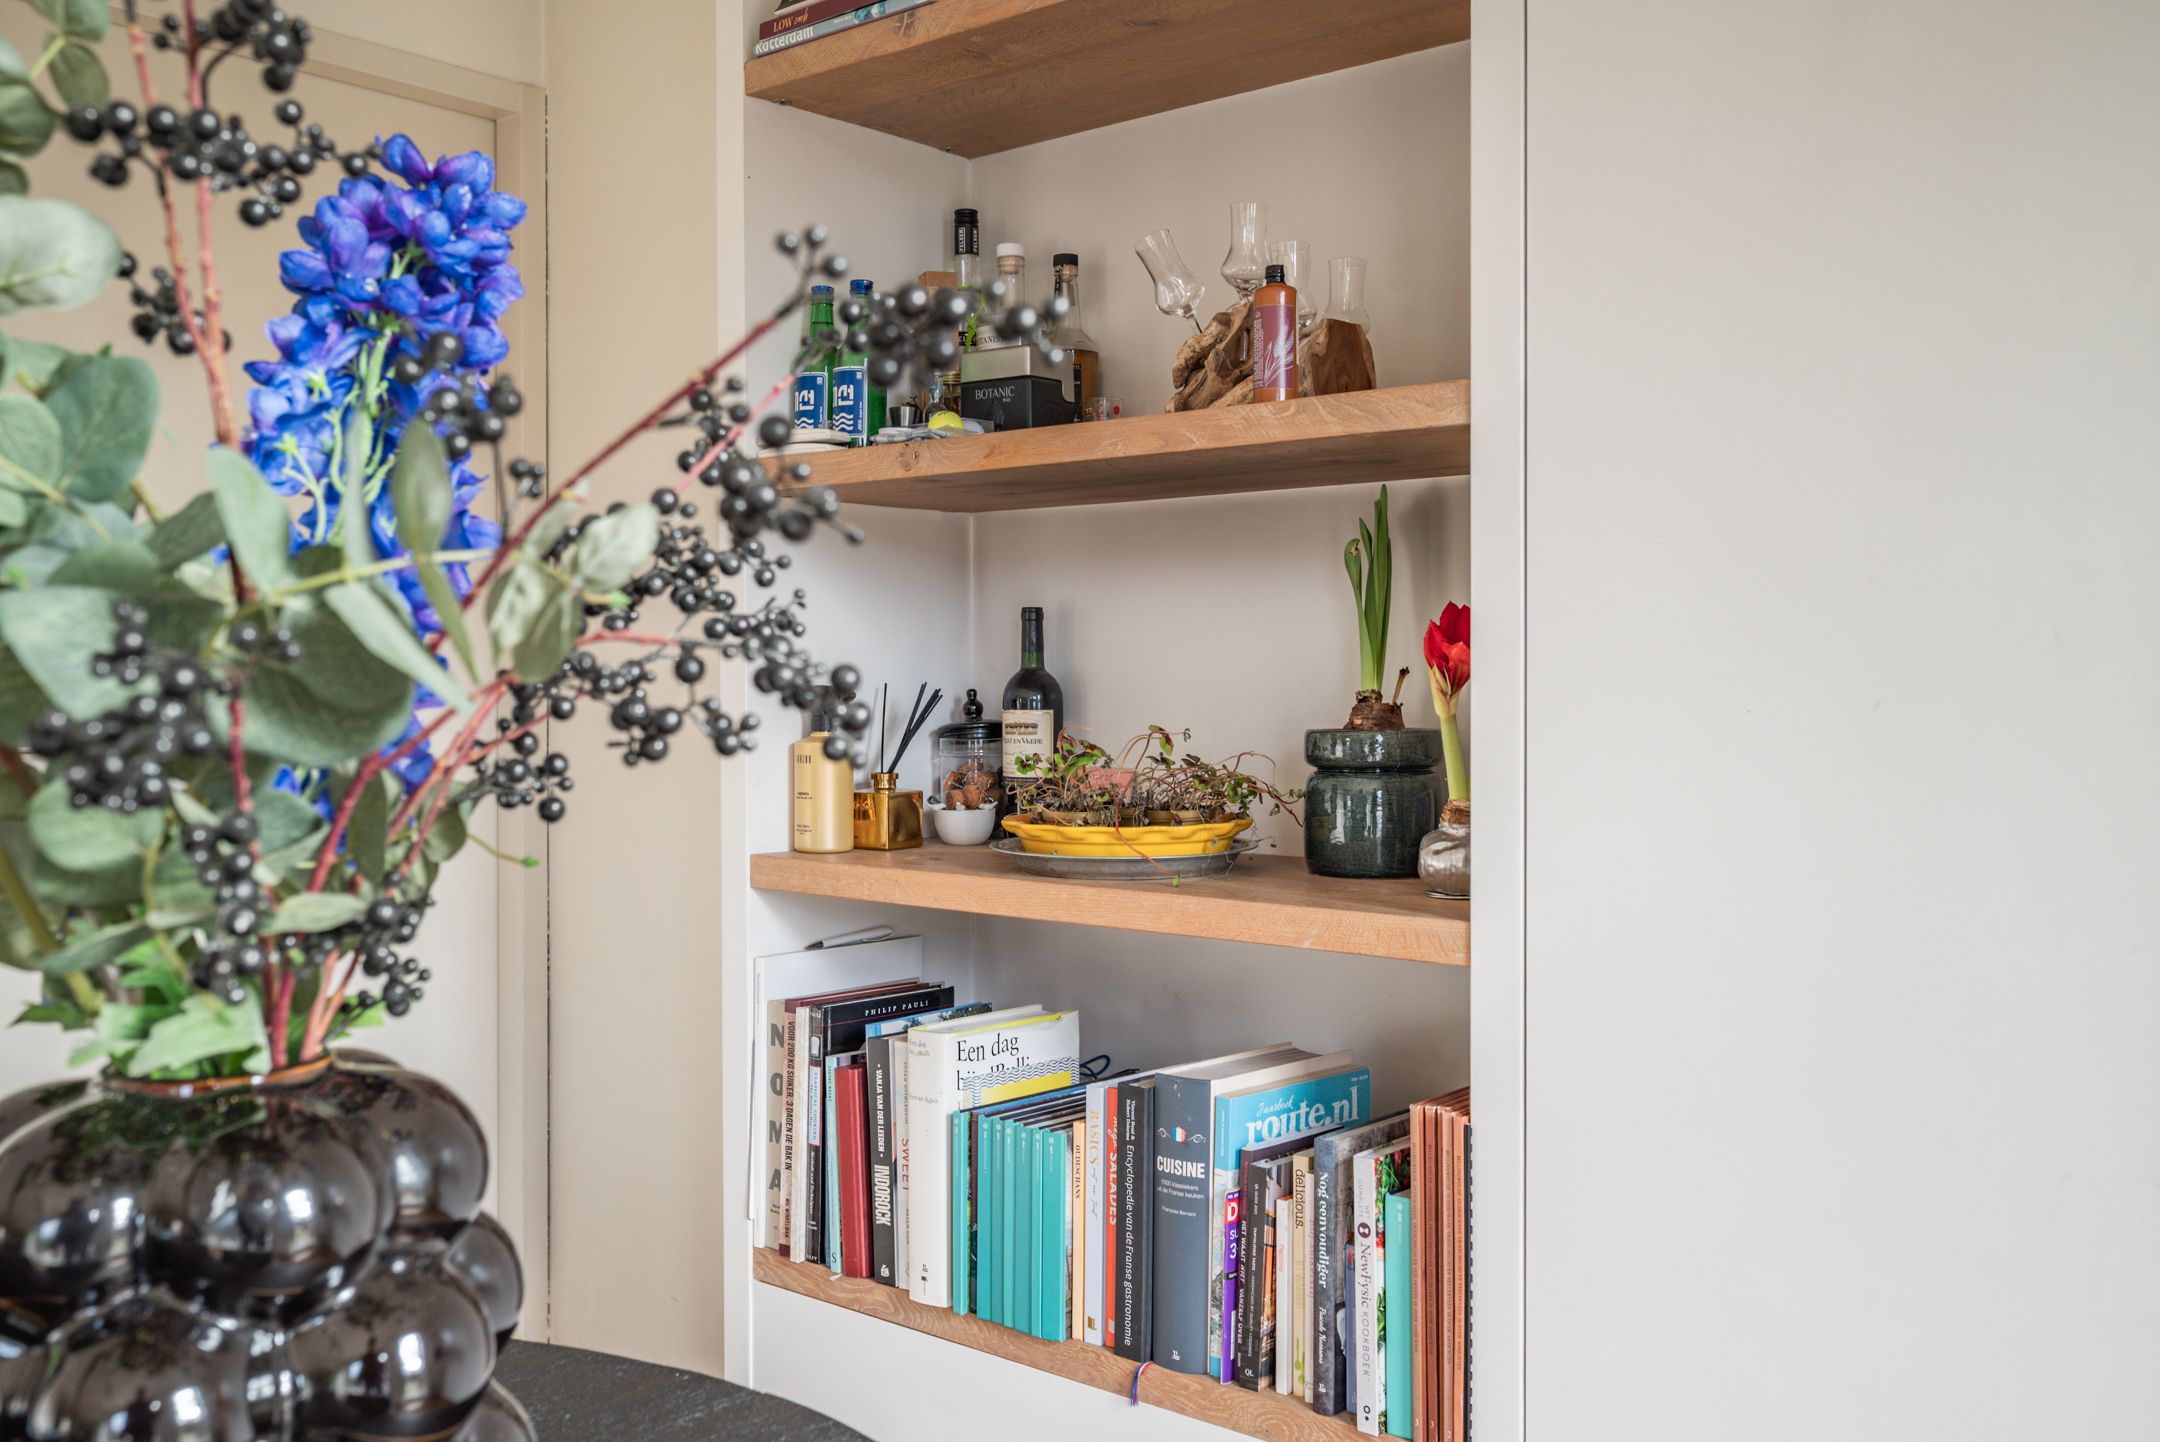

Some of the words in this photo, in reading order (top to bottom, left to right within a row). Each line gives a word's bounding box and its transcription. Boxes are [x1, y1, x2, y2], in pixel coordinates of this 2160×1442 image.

[774, 16, 794, 32] LOW
[755, 27, 814, 54] Rotterdam
[975, 386, 1016, 400] BOTANIC
[865, 1006, 897, 1016] PHILIP
[902, 1000, 929, 1010] PAULI
[957, 1040, 985, 1062] Een
[991, 1033, 1019, 1056] dag
[787, 1060, 795, 1069] KG
[785, 1071, 795, 1099] SUIKER,
[1245, 1085, 1360, 1148] route.nl
[1256, 1094, 1295, 1117] Jaarboek
[785, 1108, 794, 1132] DAGEN
[784, 1145, 793, 1160] BAK
[785, 1134, 793, 1144] DE
[877, 1126, 885, 1152] LEEDEN
[784, 1162, 793, 1171] IN
[1125, 1145, 1135, 1210] Encyclopedie
[1156, 1155, 1206, 1179] CUISINE
[874, 1165, 891, 1226] INDOROCK
[1109, 1152, 1118, 1225] SALADES
[1295, 1169, 1306, 1229] delicious.
[1317, 1172, 1329, 1199] Nog
[1126, 1232, 1134, 1245] de
[1318, 1200, 1329, 1288] eenvoudiger
[1125, 1246, 1134, 1279] Franse
[1358, 1243, 1371, 1308] NewFysic
[1123, 1281, 1133, 1346] gastronomie
[1362, 1311, 1370, 1377] KOOKBOEK
